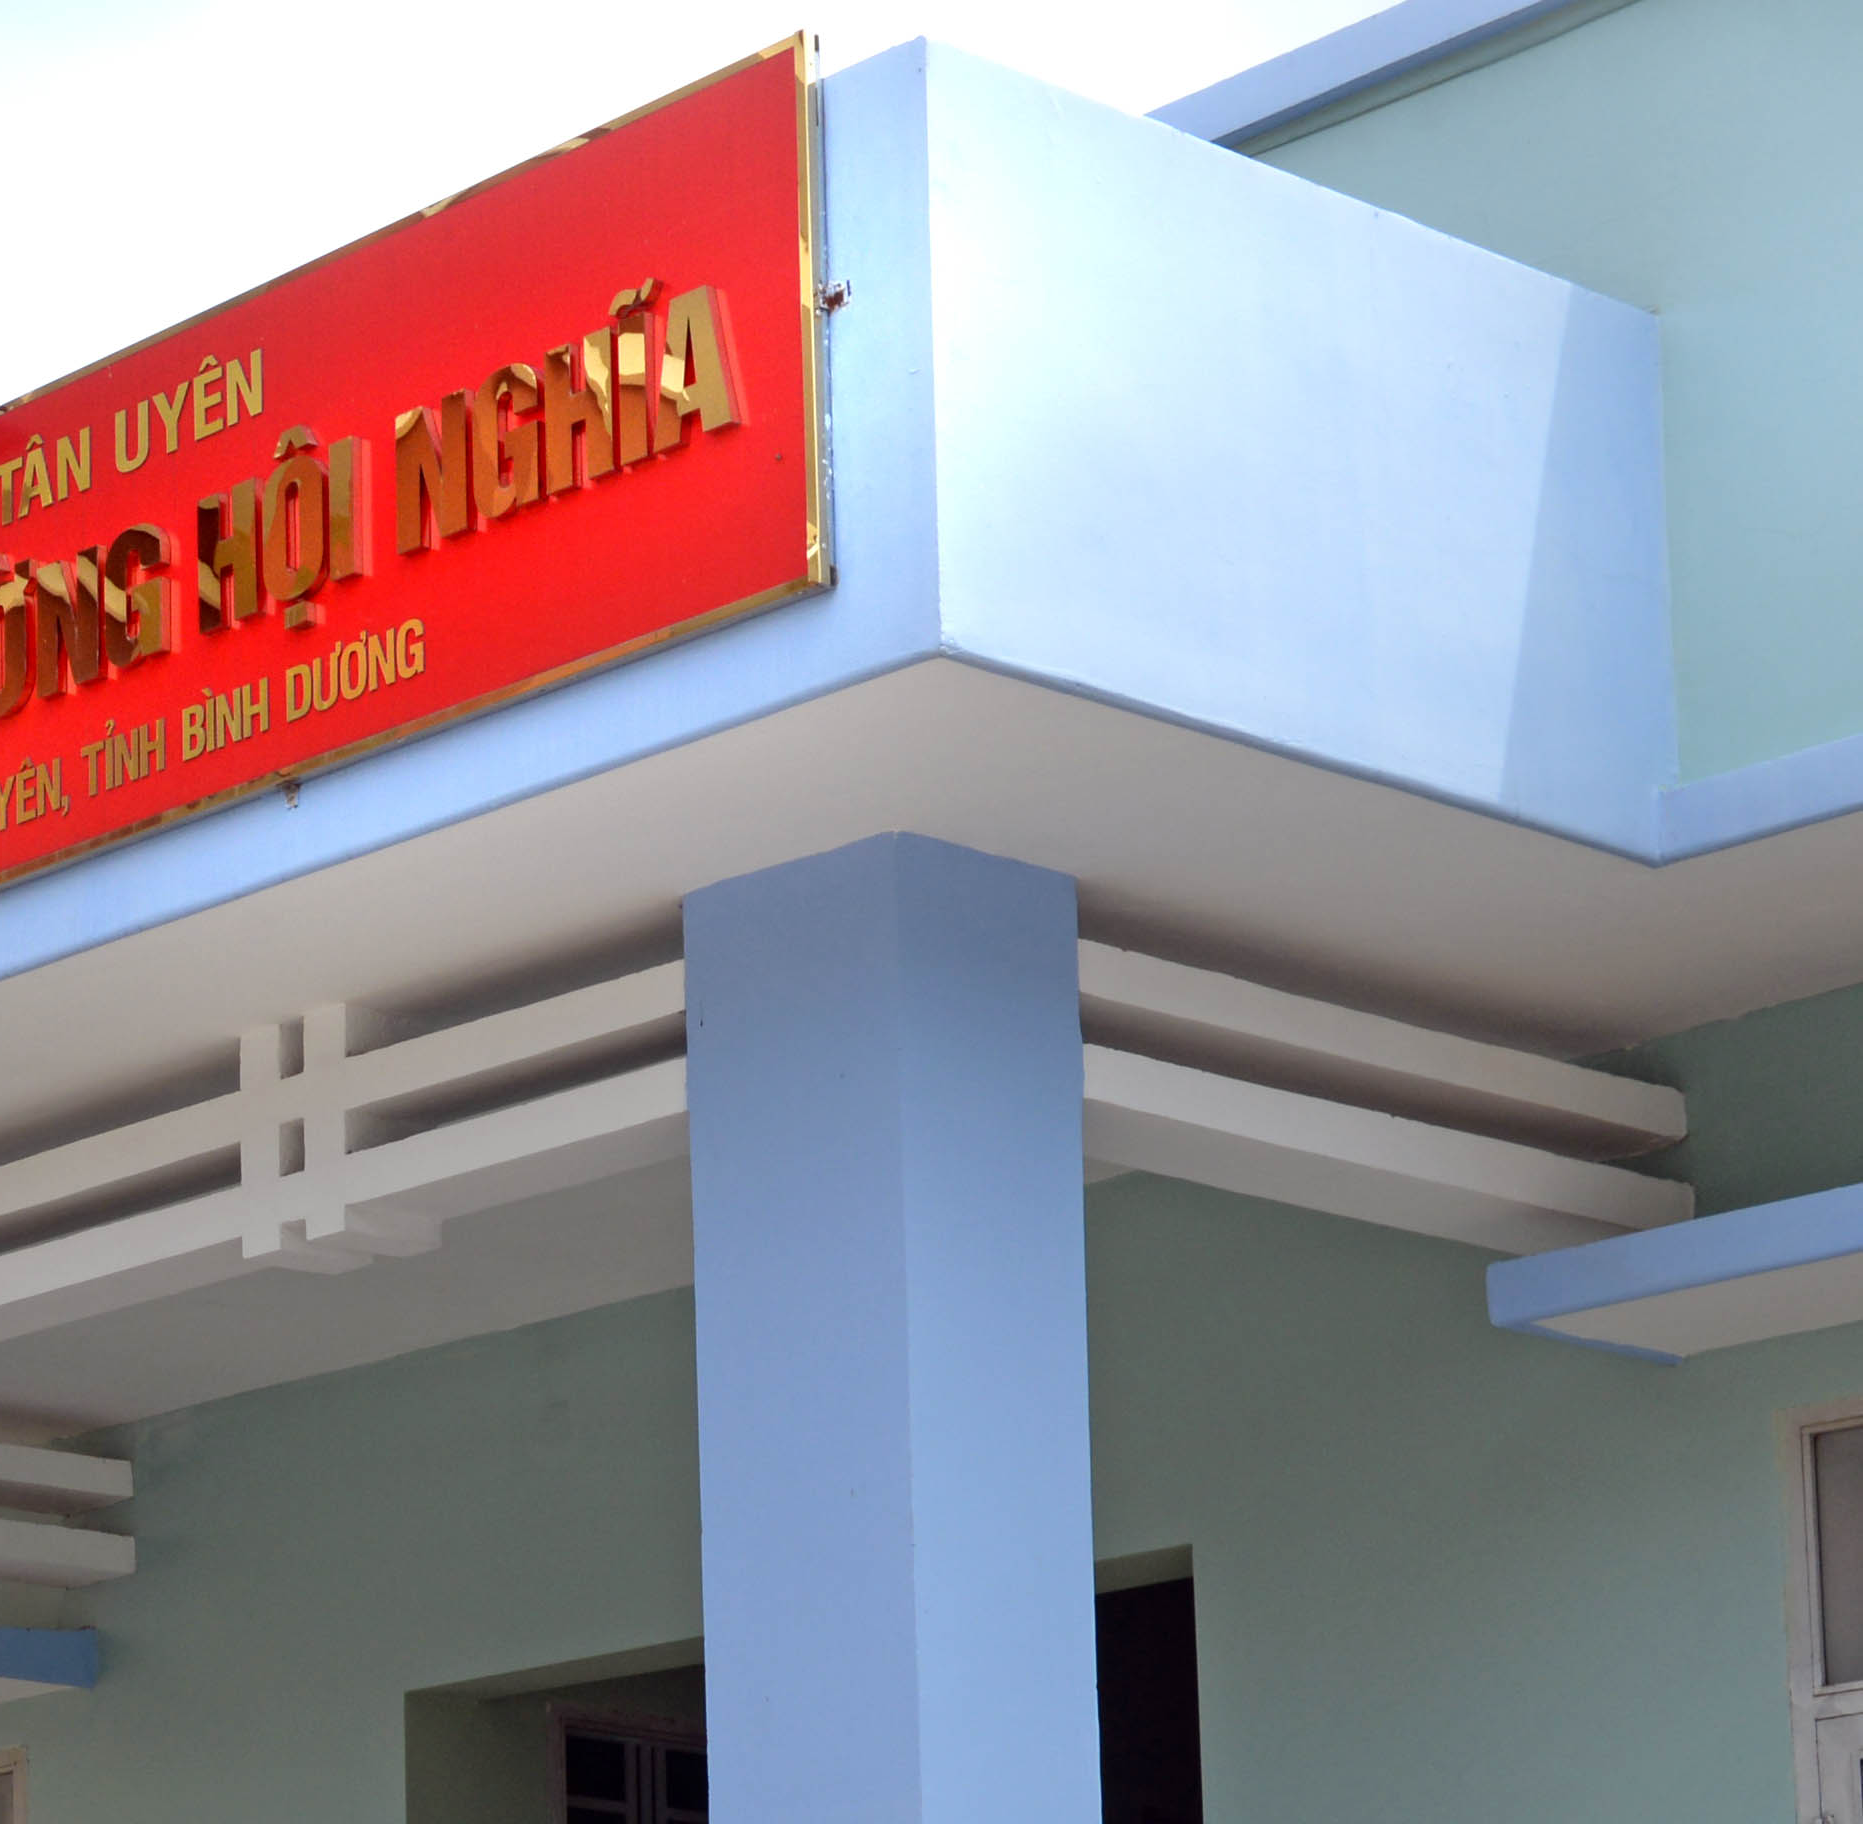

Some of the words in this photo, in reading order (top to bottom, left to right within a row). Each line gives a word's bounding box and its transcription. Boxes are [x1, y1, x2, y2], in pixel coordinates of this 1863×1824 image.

[114, 349, 263, 474] UYÊN
[197, 424, 362, 635] HỘI
[395, 277, 740, 556] NGHĨA
[81, 718, 166, 797] TỈNH
[182, 677, 269, 761] BÌNH
[286, 618, 426, 723] DƯƠNG
